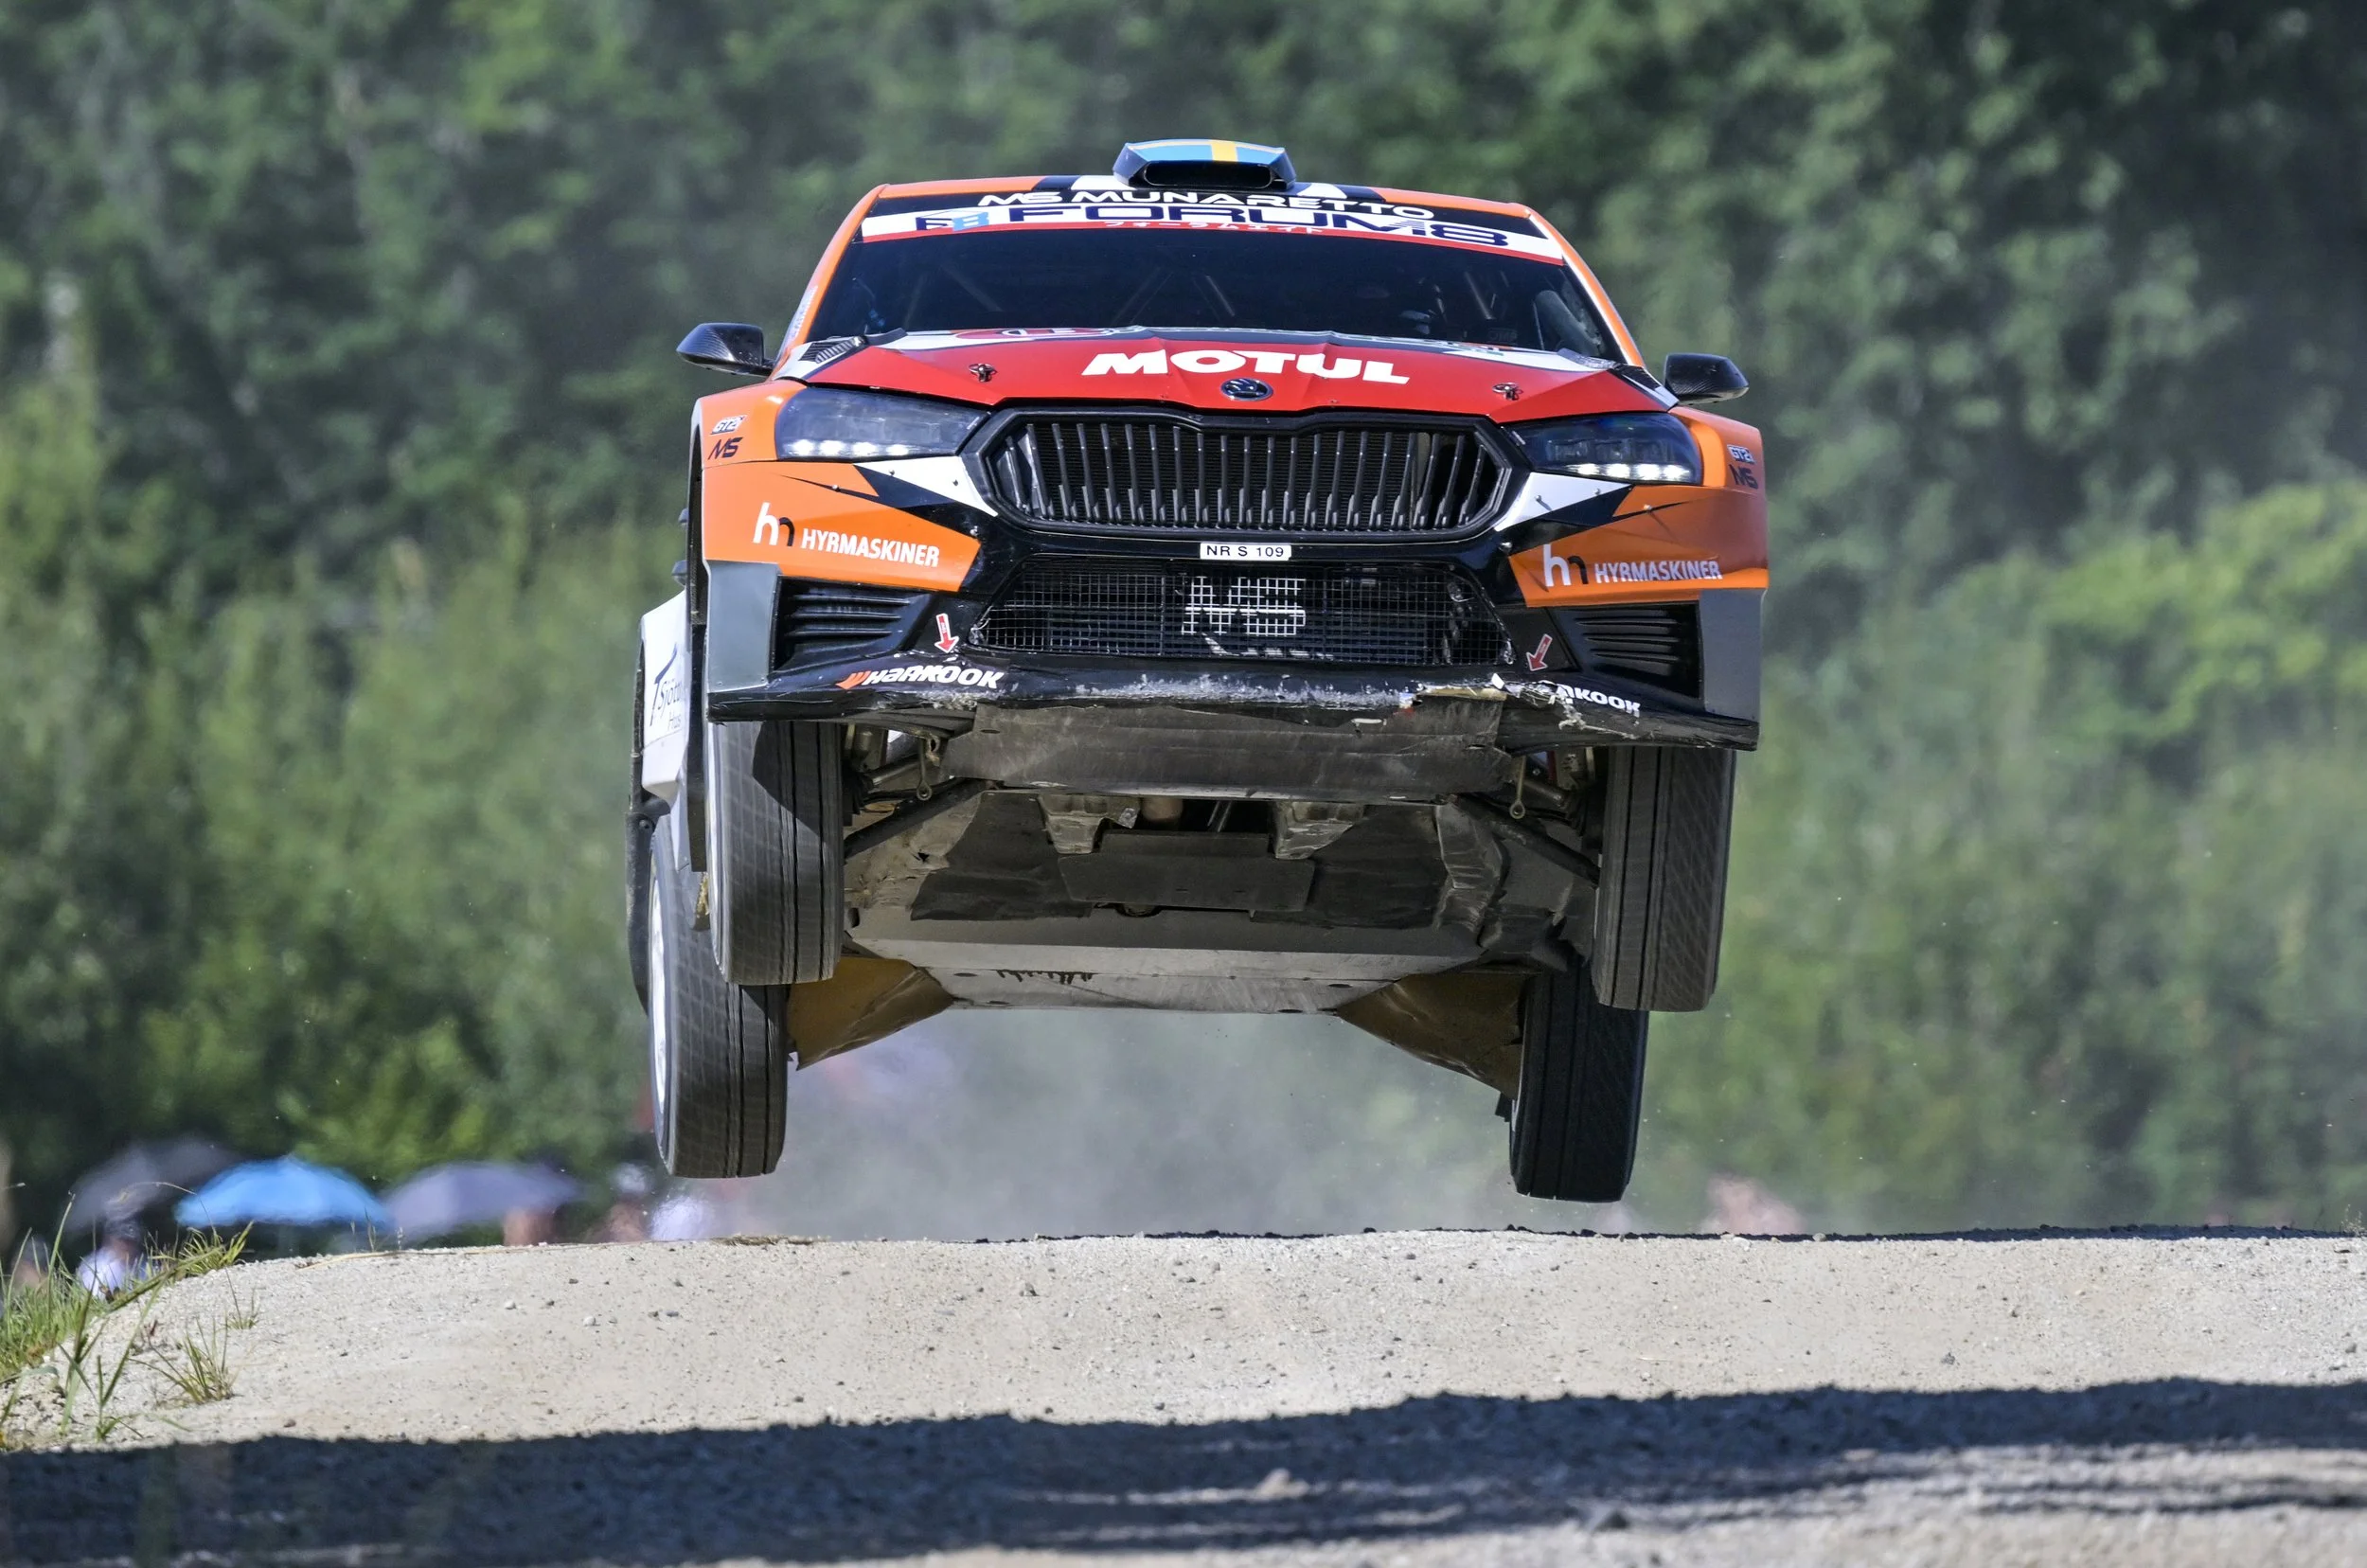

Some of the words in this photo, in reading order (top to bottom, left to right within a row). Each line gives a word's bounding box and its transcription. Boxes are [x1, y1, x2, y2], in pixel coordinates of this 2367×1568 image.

[978, 191, 1062, 205] MS
[1071, 191, 1434, 220] MUNARETTO
[1008, 205, 1509, 247] FORUM8
[1081, 349, 1410, 384] MOTUL
[708, 437, 744, 460] MS
[1728, 464, 1759, 490] MS
[800, 527, 940, 567] HYRMASKINER
[1206, 545, 1230, 556] NR
[1237, 546, 1248, 557] S
[1255, 547, 1284, 557] 109
[1594, 560, 1723, 583] HYRMASKINER
